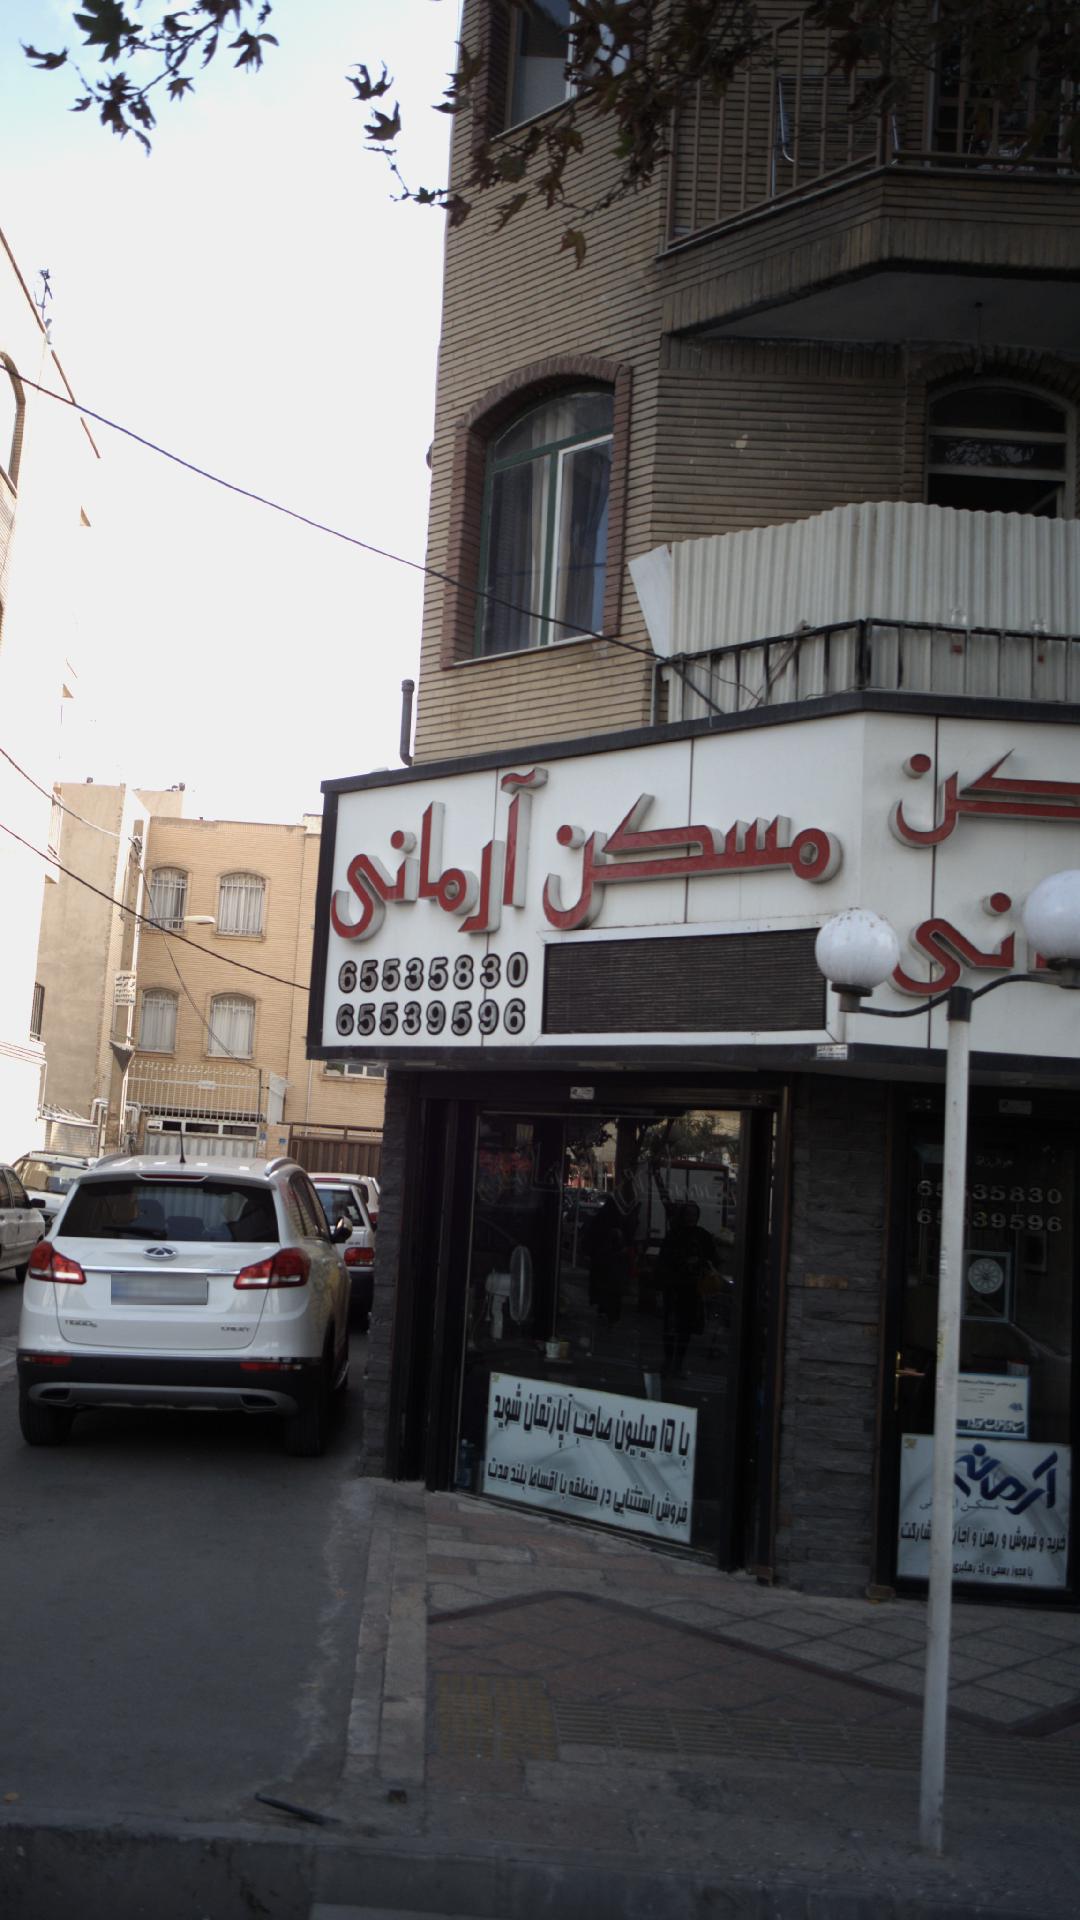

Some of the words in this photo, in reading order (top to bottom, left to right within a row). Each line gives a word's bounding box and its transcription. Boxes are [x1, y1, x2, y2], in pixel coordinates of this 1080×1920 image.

[888, 748, 1080, 848] کن
[331, 766, 549, 942] آرمانی
[543, 792, 842, 931] مسکن
[337, 951, 529, 994] 65535830
[336, 997, 527, 1037] 65539596
[916, 1179, 1063, 1205] 635830
[916, 1208, 1063, 1232] 639596
[493, 1383, 522, 1428] شوید
[524, 1393, 574, 1449] آپارتمان
[574, 1406, 612, 1447] صاحب
[614, 1410, 656, 1458] میلیون
[679, 1423, 690, 1467] با
[488, 1458, 509, 1481] مدت
[510, 1463, 526, 1494] بلند
[529, 1467, 558, 1491] اقساط
[560, 1473, 566, 1502] با
[569, 1478, 598, 1501] منطقه
[600, 1489, 611, 1506] در
[613, 1485, 655, 1513] استثنایی
[656, 1492, 688, 1524] فروش
[901, 1521, 932, 1543] شارکت
[953, 1527, 969, 1547] اجار
[981, 1529, 998, 1547] رهن
[1009, 1526, 1036, 1550] فروش
[1047, 1533, 1066, 1554] خرید
